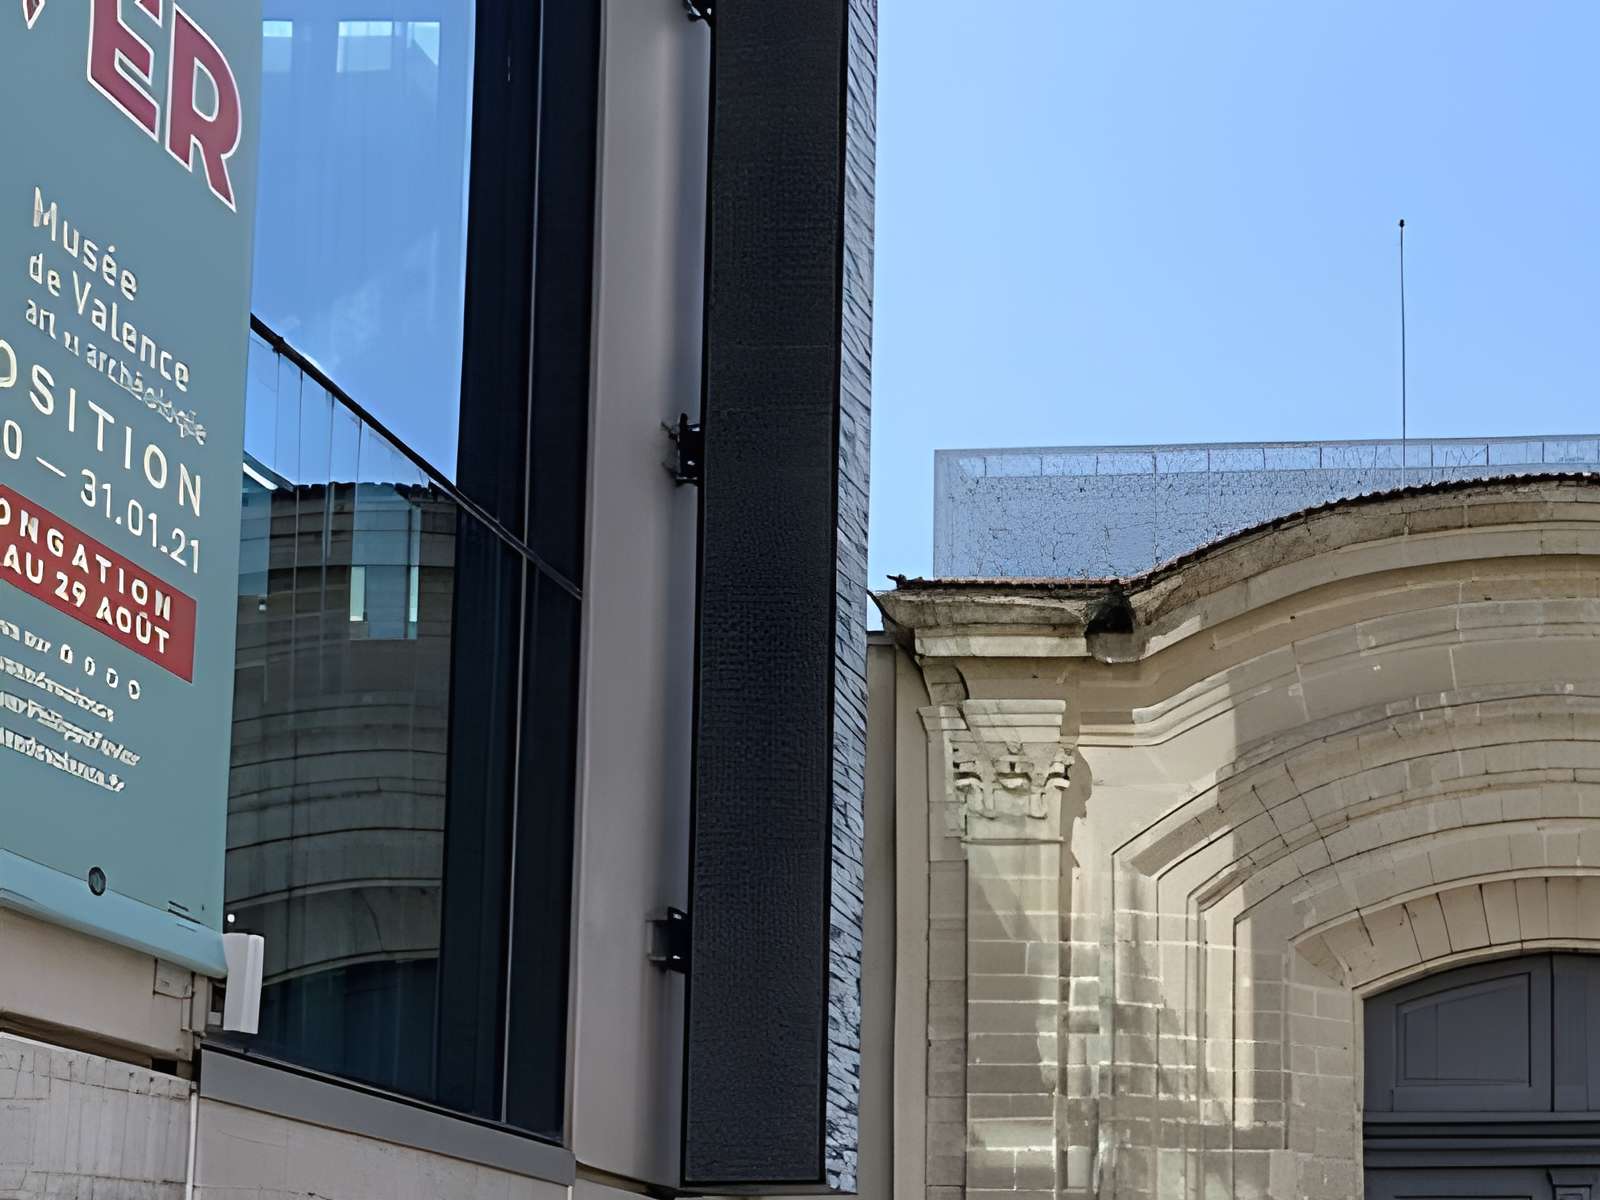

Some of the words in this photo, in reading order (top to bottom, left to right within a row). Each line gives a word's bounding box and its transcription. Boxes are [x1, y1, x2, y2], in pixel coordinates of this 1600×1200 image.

[22, 0, 243, 213] ER
[32, 186, 138, 301] Musée
[29, 252, 62, 297] de
[72, 269, 190, 393] Valence
[80, 468, 200, 574] 31.01.21
[54, 571, 87, 608] 29
